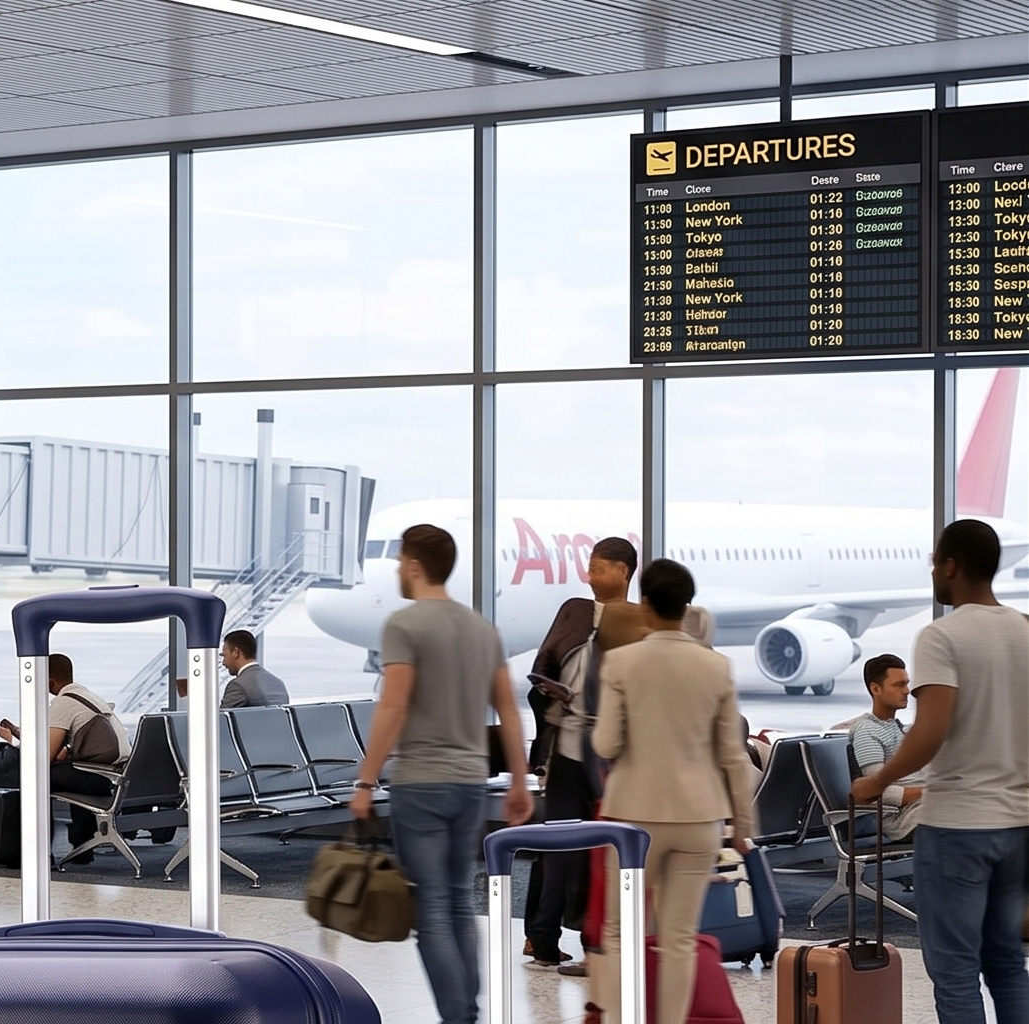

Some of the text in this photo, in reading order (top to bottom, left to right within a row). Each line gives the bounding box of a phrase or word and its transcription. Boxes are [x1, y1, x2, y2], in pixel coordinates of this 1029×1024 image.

[686, 133, 856, 169] DEPARTURES
[950, 165, 976, 175] Time
[646, 188, 669, 197] Time
[685, 200, 731, 213] London
[810, 192, 843, 204] 01:22
[948, 198, 980, 211] 13:00
[685, 217, 712, 228] New
[715, 214, 743, 226] York
[948, 214, 980, 227] 13:30
[685, 232, 722, 245] Tokyo
[810, 224, 843, 236] 01:30
[948, 247, 980, 260] 15:30
[948, 263, 980, 276] 15:30
[685, 294, 712, 305] New
[714, 292, 743, 303] York
[994, 295, 1023, 307] New
[810, 319, 843, 331] 01:20
[948, 312, 980, 325] 18:30
[810, 335, 843, 346] 01:20
[948, 328, 1023, 341] 18:30 New
